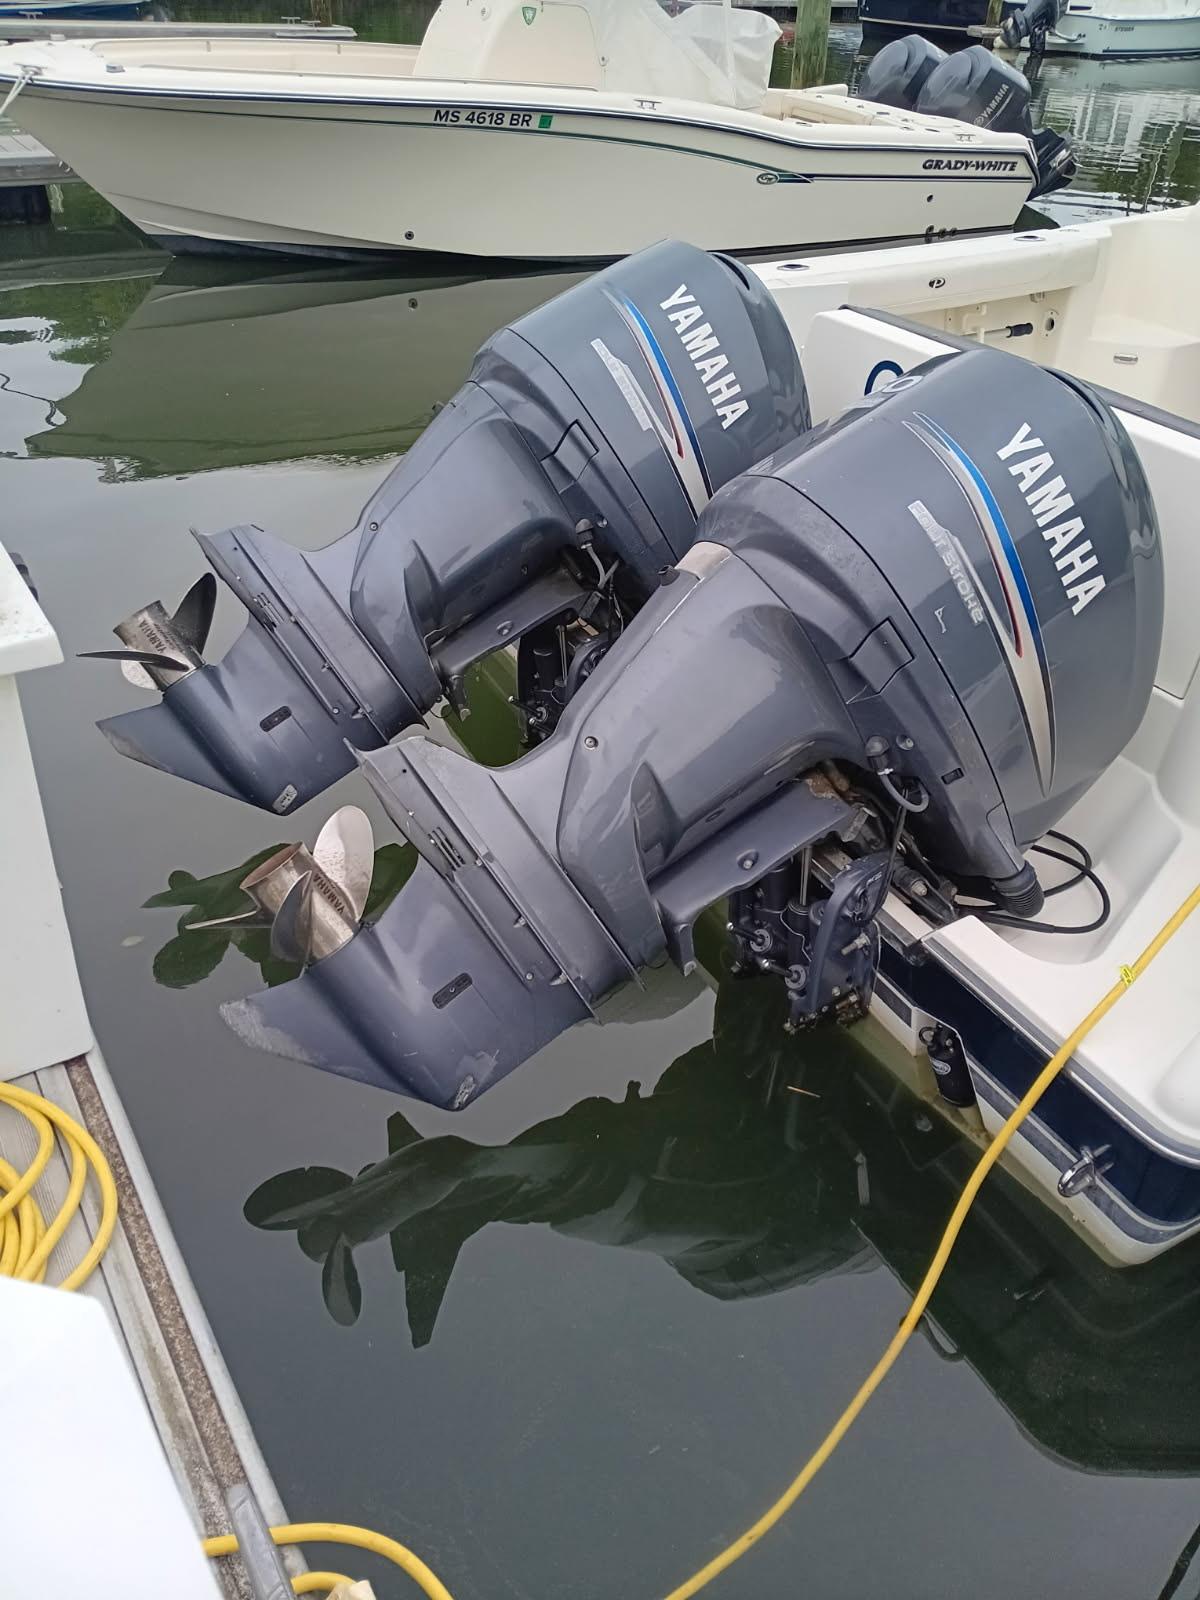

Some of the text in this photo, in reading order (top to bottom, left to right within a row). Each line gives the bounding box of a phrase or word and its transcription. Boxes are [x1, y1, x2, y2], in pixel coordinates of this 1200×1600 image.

[433, 109, 460, 123] MS
[464, 111, 505, 126] 4618
[509, 113, 532, 127] BR
[981, 82, 1010, 118] YAMAHA
[922, 158, 1018, 172] GRADY-WHITE
[659, 283, 749, 430] YAMAHA
[996, 422, 1106, 616] YAMAHA
[314, 873, 346, 914] YAMAHA
